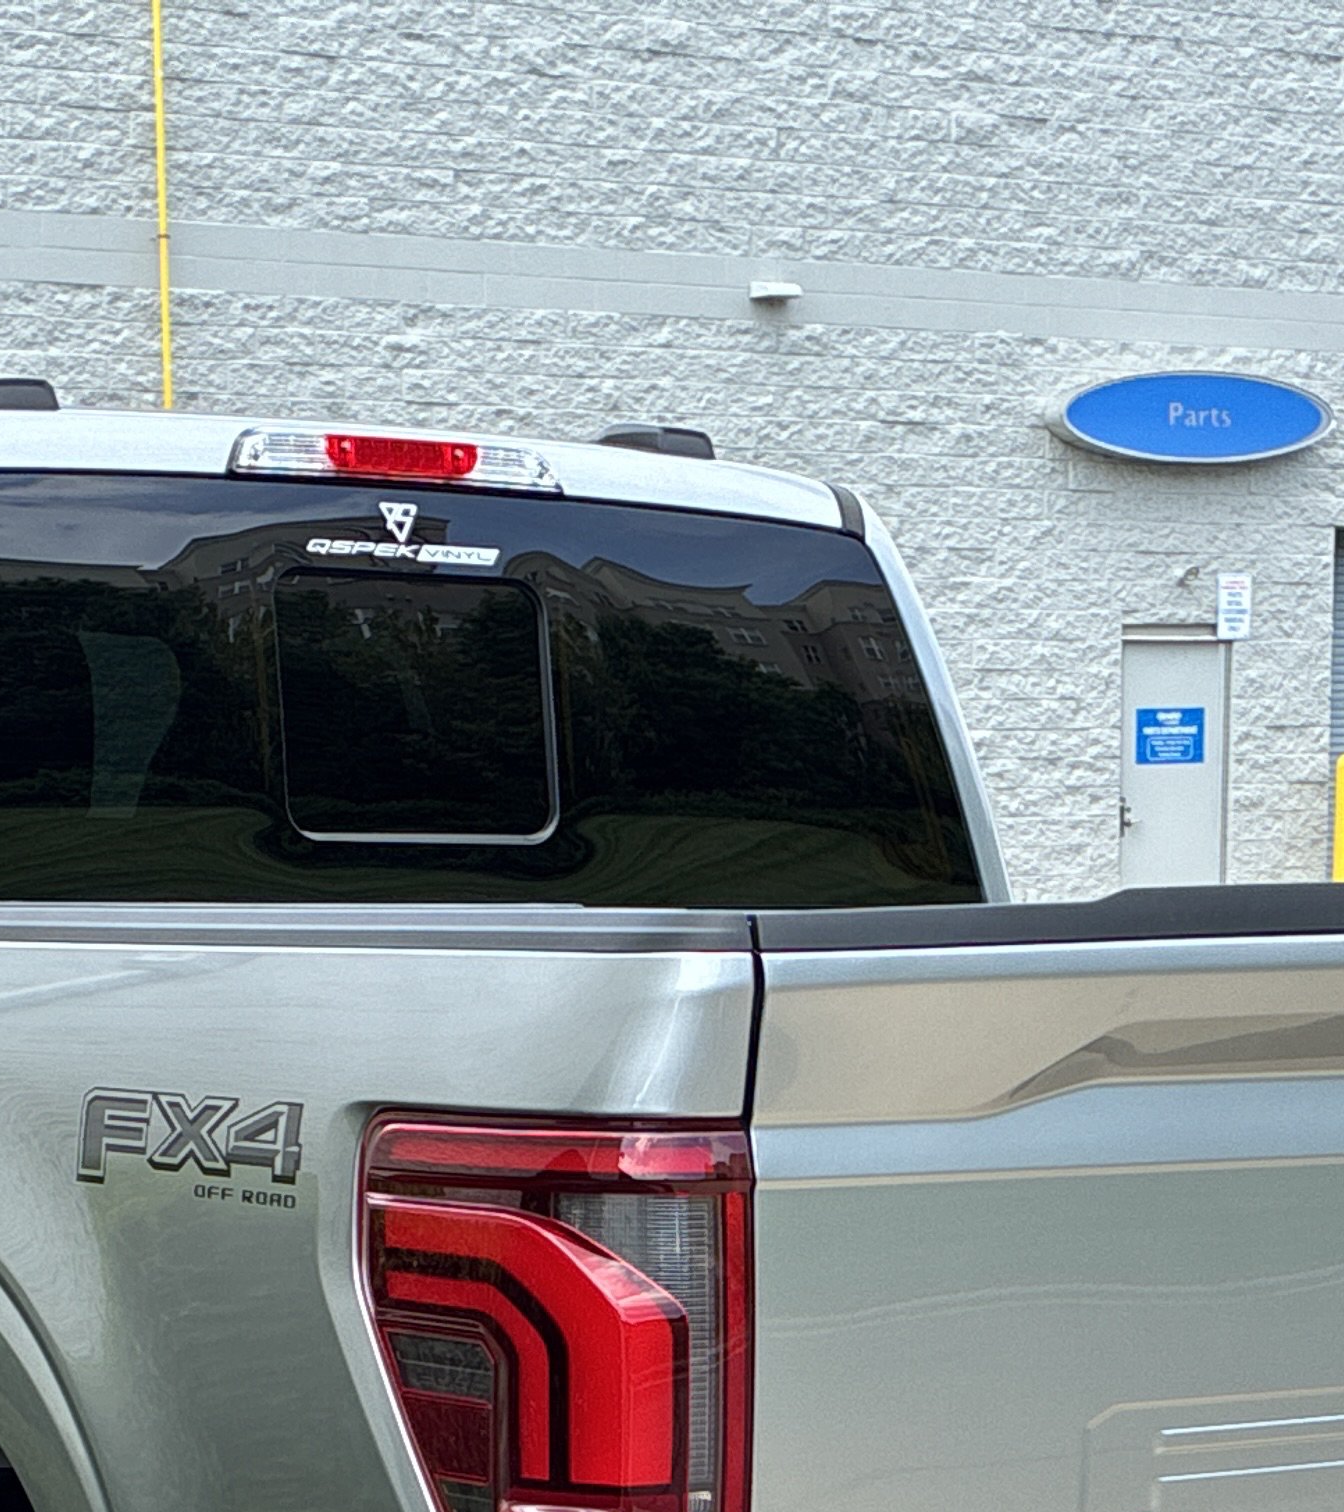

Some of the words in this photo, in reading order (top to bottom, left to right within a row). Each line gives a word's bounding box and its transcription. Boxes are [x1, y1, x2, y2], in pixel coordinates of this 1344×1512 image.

[1168, 401, 1232, 428] Parts
[306, 538, 420, 559] QSPEK
[423, 547, 494, 564] VINYL
[76, 1086, 304, 1185] FX4
[193, 1184, 234, 1201] OFF
[240, 1188, 297, 1209] ROAD
